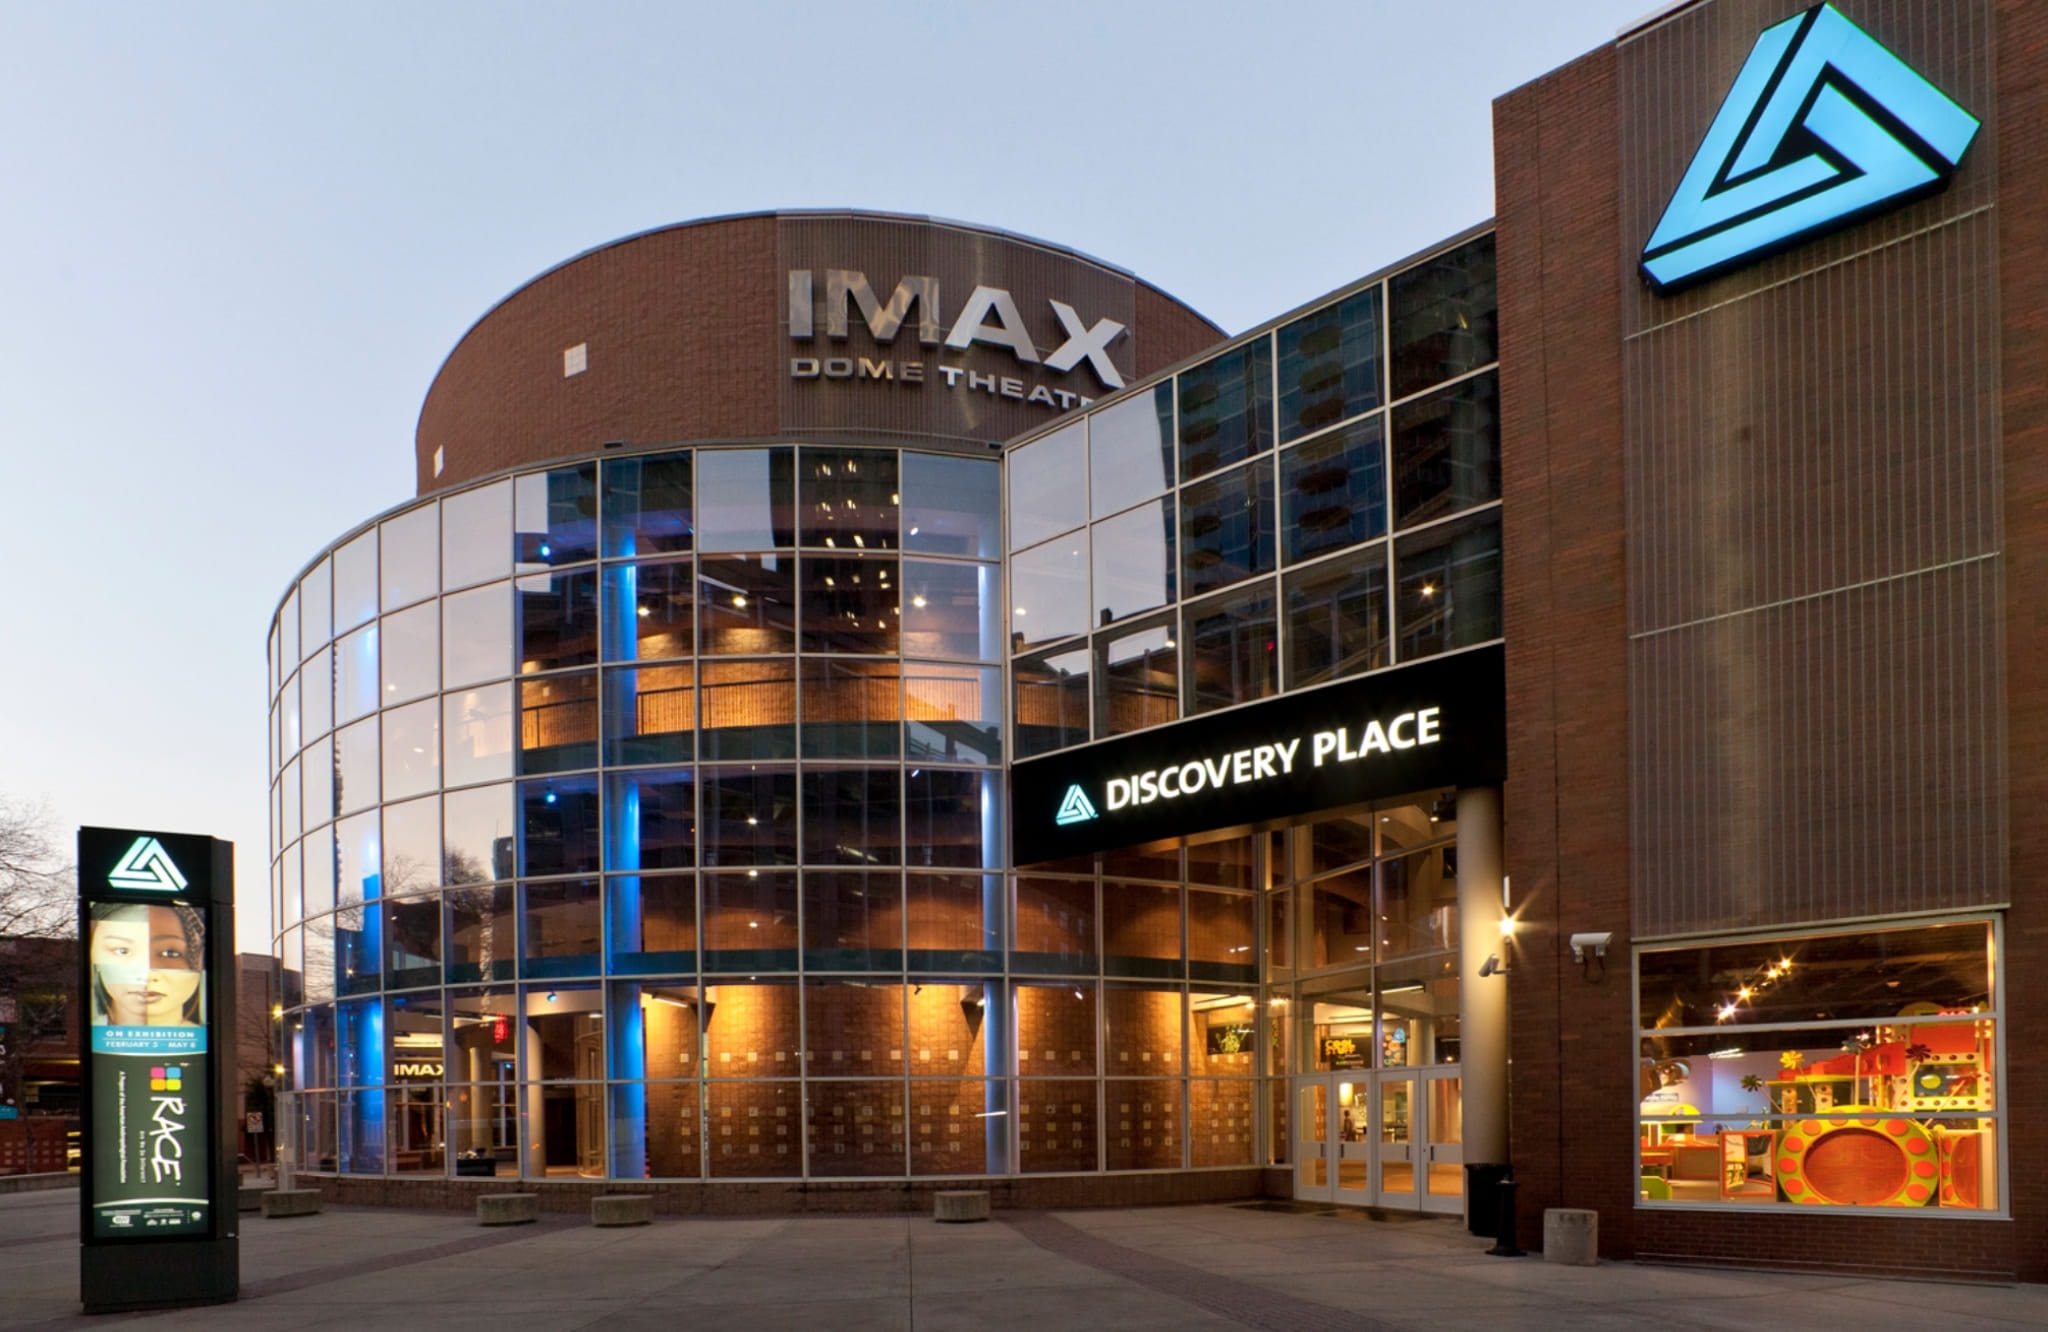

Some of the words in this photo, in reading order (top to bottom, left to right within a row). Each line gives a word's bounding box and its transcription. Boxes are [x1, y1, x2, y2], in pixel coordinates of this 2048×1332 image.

[789, 269, 1126, 390] IMAX
[791, 357, 925, 382] DOME
[1106, 738, 1301, 812] DISCOVERY
[1313, 706, 1441, 767] PLACE
[149, 1096, 185, 1183] RACE
